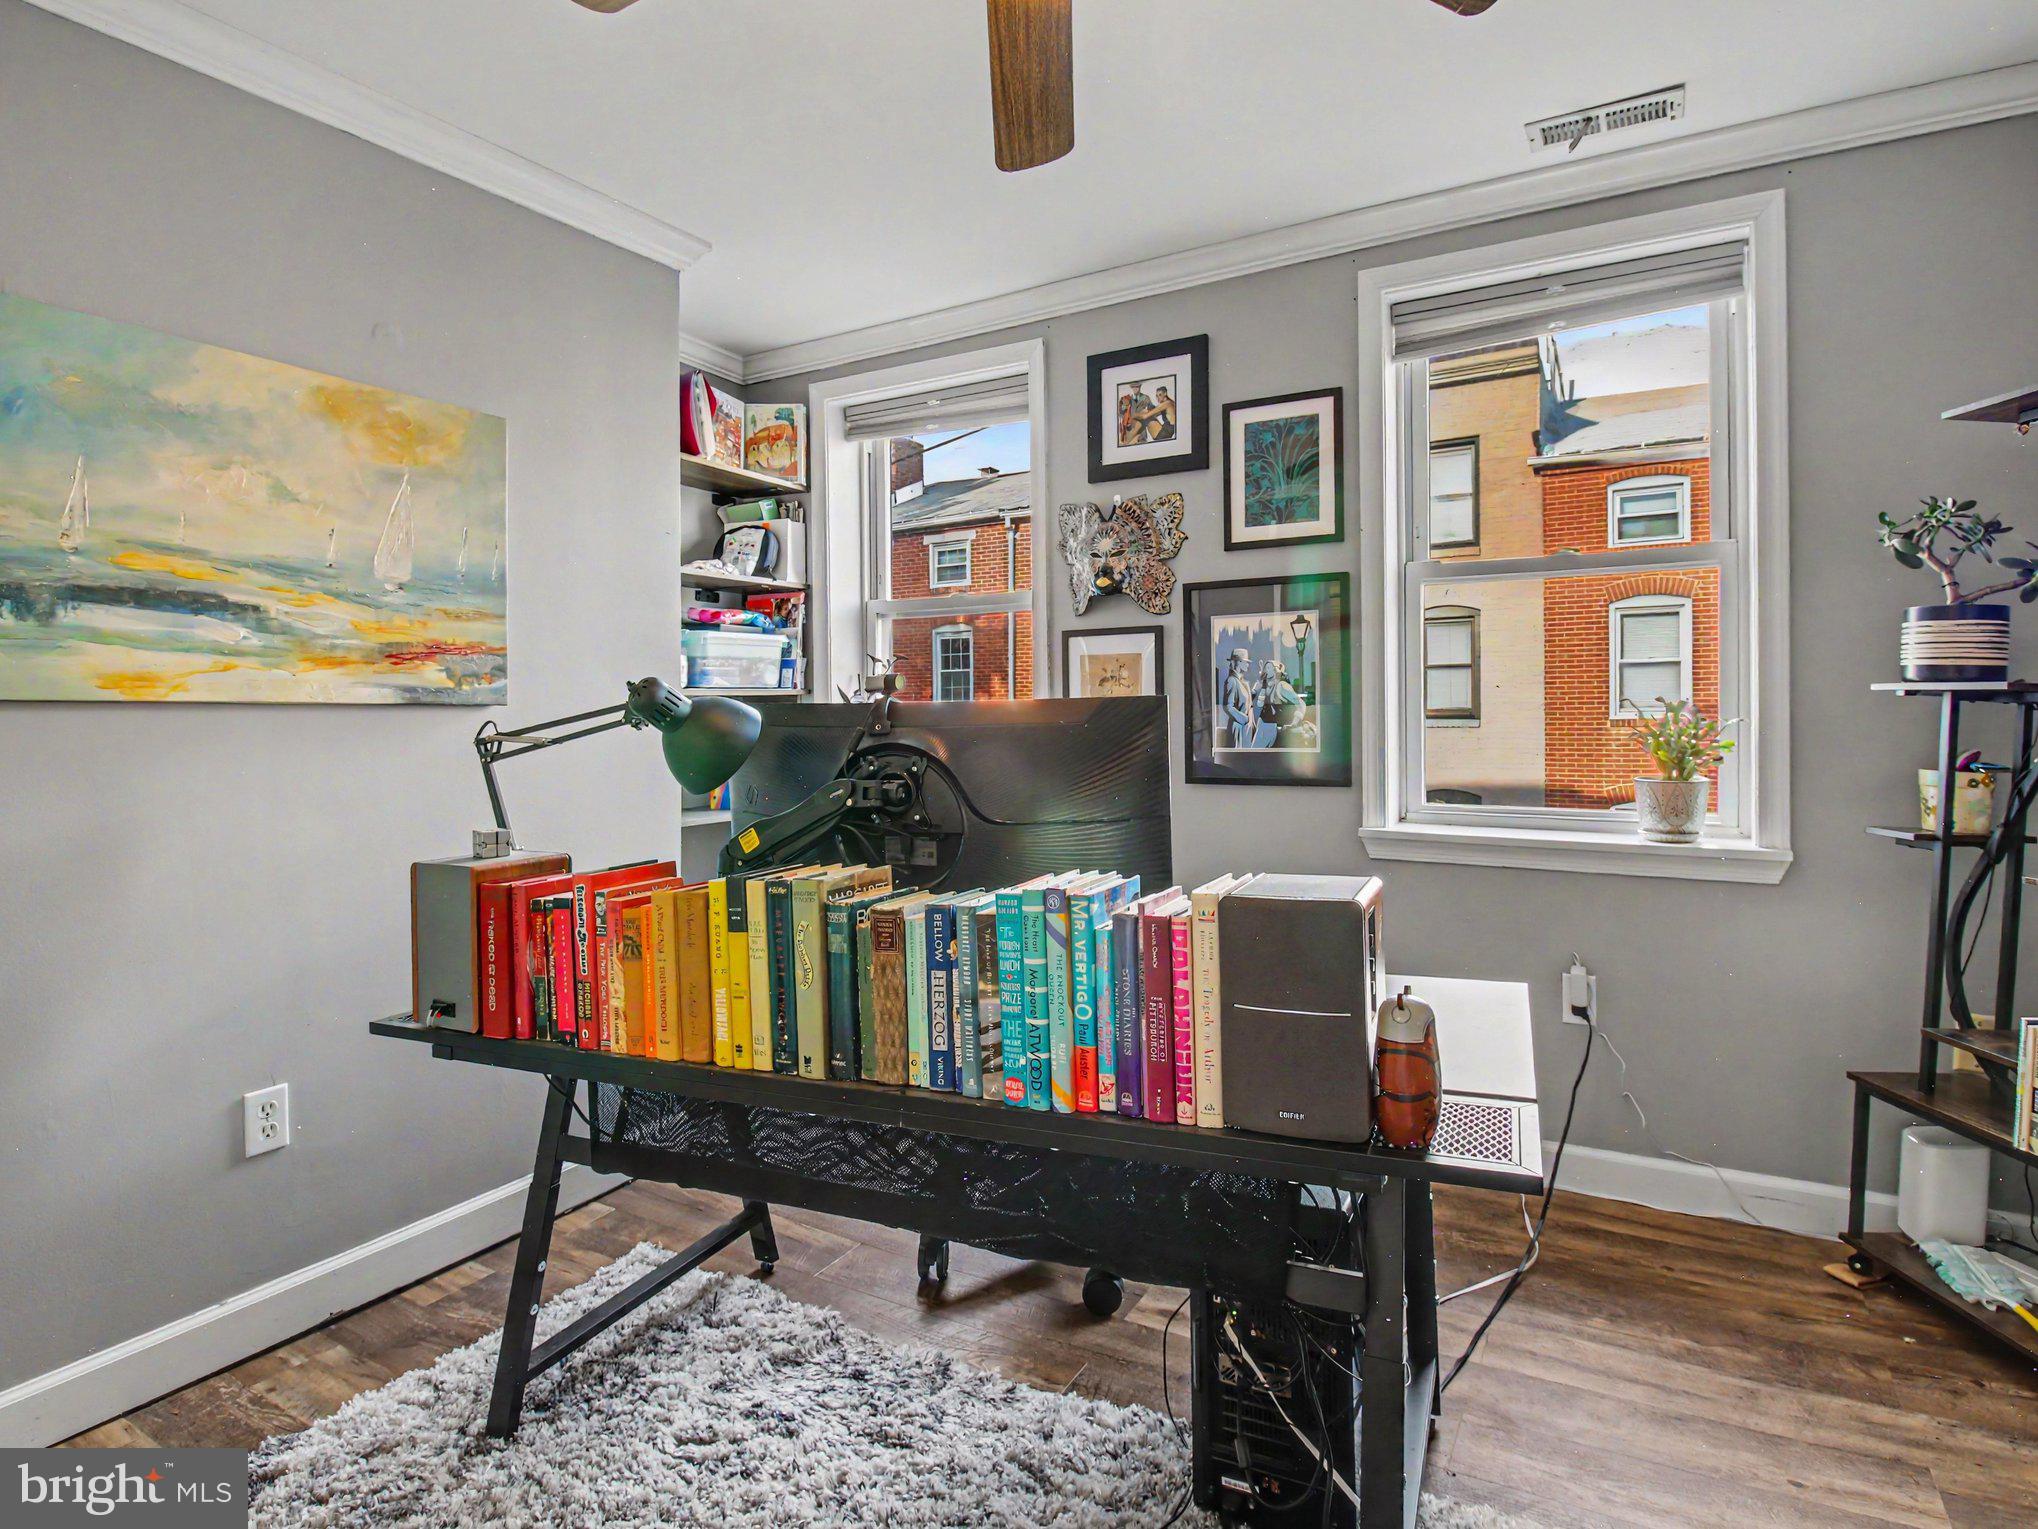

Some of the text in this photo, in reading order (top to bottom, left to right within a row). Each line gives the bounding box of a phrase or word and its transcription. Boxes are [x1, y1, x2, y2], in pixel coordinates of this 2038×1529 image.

[933, 913, 943, 963] BELLOW
[1031, 930, 1039, 953] Heart
[1071, 900, 1093, 1020] MR. VERTIGO
[933, 973, 946, 1046] HERZOG
[1001, 991, 1022, 1005] PRIZE
[1056, 974, 1065, 1027] KNOCKOUT
[1121, 968, 1133, 1056] STONE DIARIES
[1172, 929, 1194, 1106] PALAHNIUK
[1002, 1020, 1022, 1038] THE
[1027, 968, 1042, 1091] Margaret ATWOOD
[1078, 1023, 1090, 1079] Paul Auster
